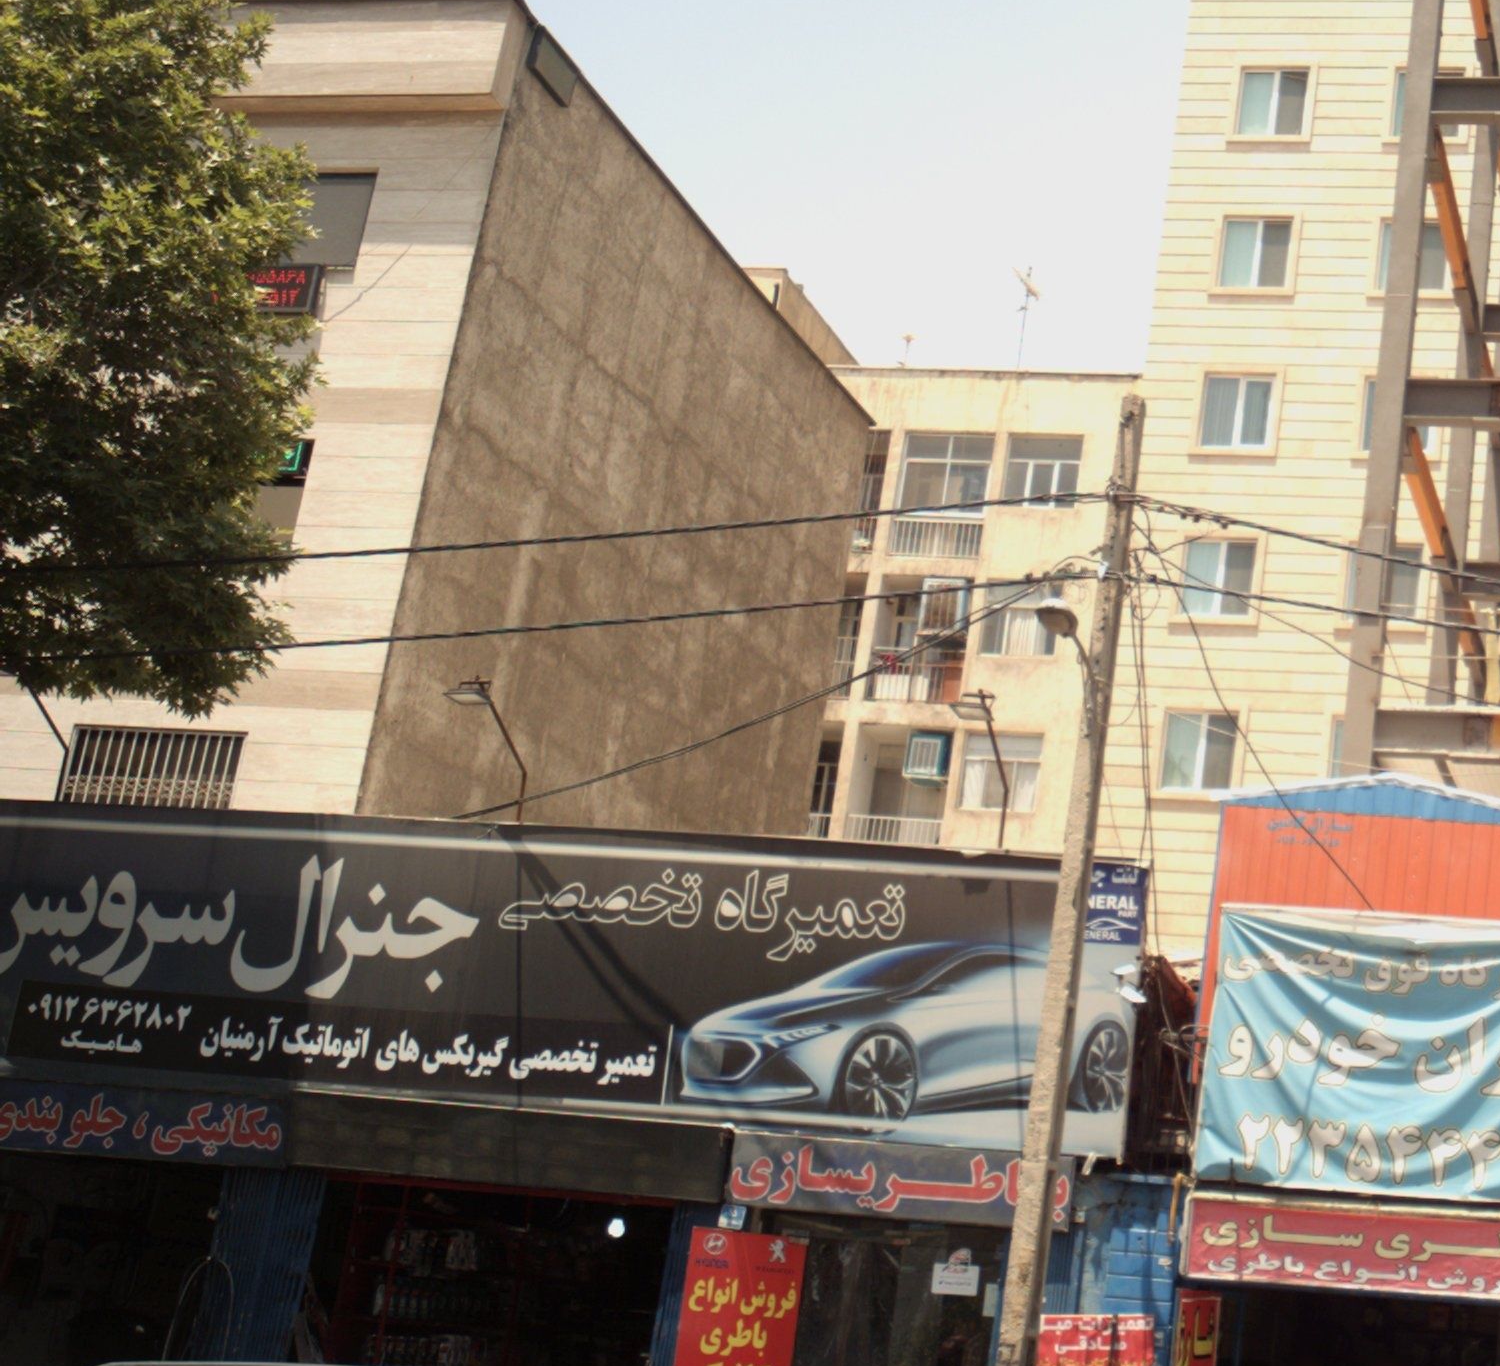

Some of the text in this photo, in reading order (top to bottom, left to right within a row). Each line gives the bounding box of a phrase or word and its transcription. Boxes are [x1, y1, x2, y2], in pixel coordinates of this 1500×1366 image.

[499, 868, 703, 930] تخصصی
[0, 871, 235, 987] سرویس
[230, 854, 480, 999] جنرال
[1223, 949, 1356, 982] تخصصی
[1363, 953, 1430, 995] فوق
[60, 1030, 143, 1055] هامیک
[200, 1016, 657, 1085] تعمیر تخصصی گیربکس های اتوماتیک آرمنیان
[1218, 1013, 1401, 1087] خودرو
[1202, 1214, 1366, 1249] سازی
[1207, 1252, 1305, 1275] باطری
[1313, 1260, 1419, 1284] انواع
[688, 1276, 797, 1318] فروش انواع
[699, 1319, 767, 1357] باطری
